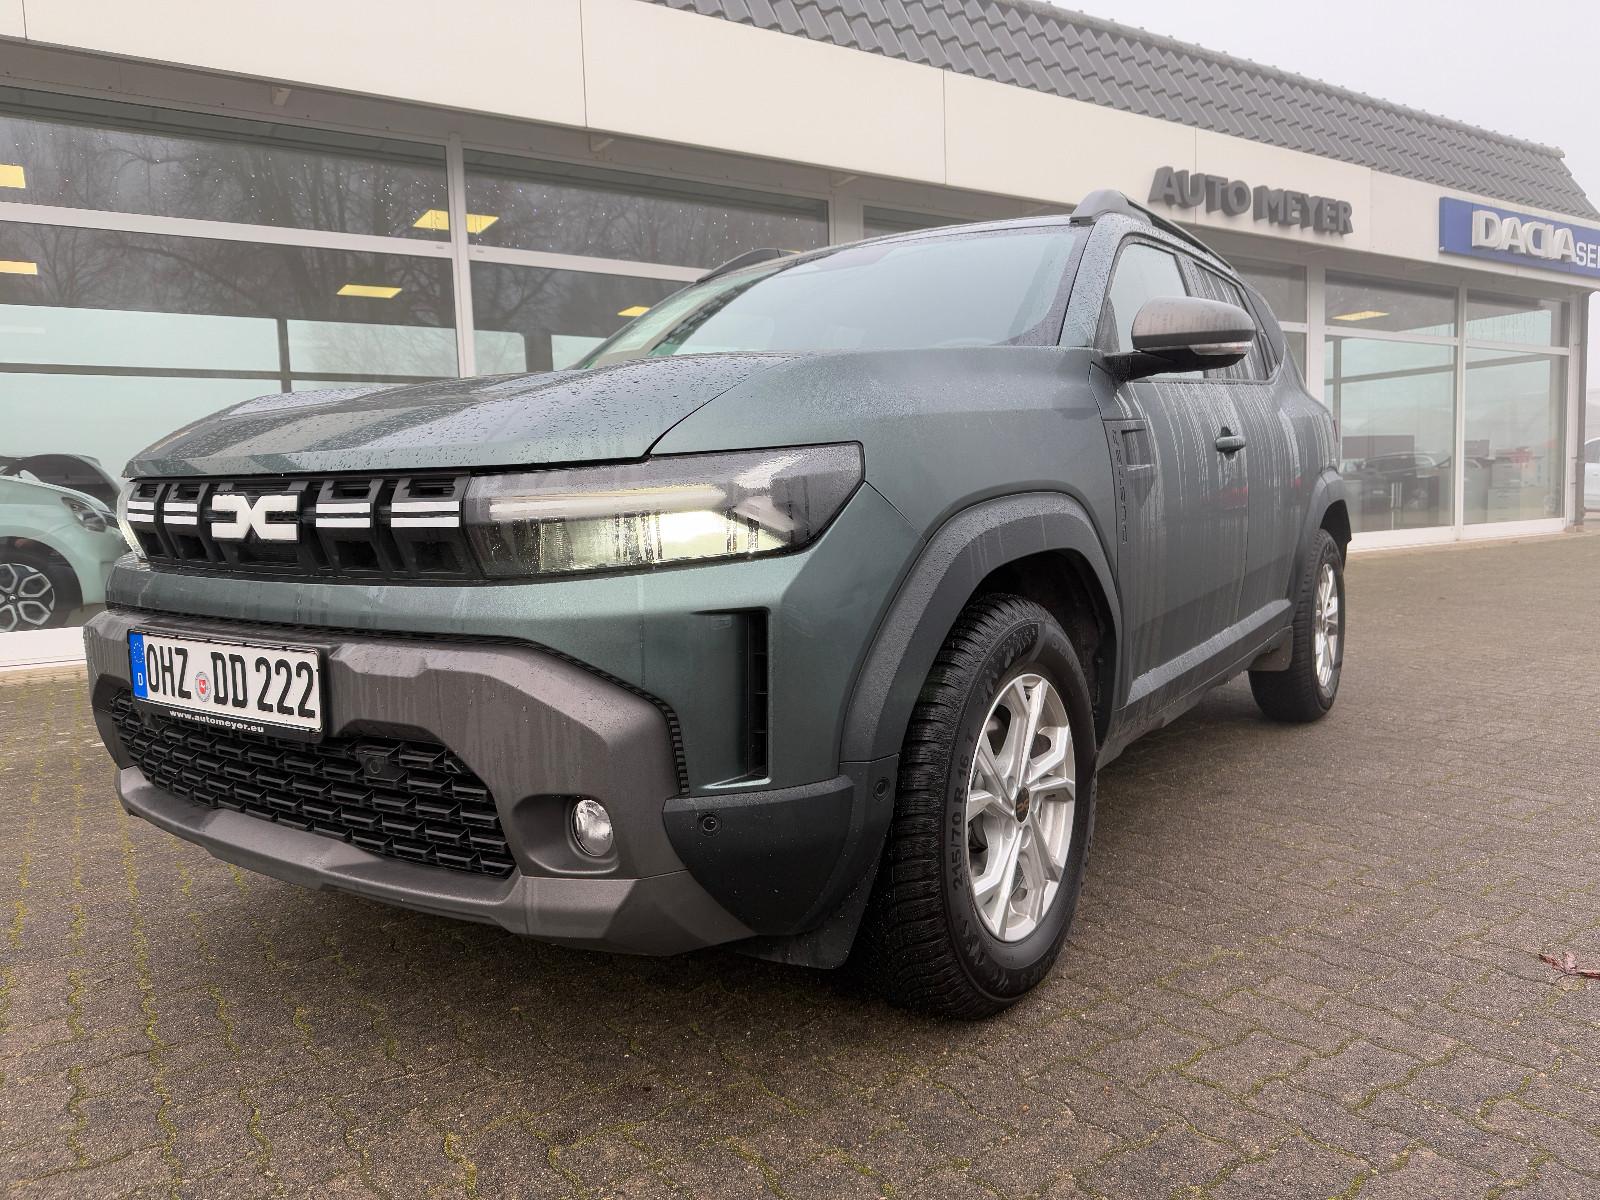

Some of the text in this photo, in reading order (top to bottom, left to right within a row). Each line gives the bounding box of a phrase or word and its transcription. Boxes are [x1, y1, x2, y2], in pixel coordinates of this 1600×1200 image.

[1148, 166, 1353, 235] AUTO MEYER
[1472, 210, 1600, 269] DACIA SE
[138, 672, 144, 686] D
[146, 643, 192, 699] OHZ
[210, 651, 248, 708] DD
[254, 656, 316, 718] 222
[169, 709, 265, 733] www.automeyer.eu
[957, 753, 970, 779] 16
[954, 786, 966, 804] R
[951, 811, 964, 891] 215/70
